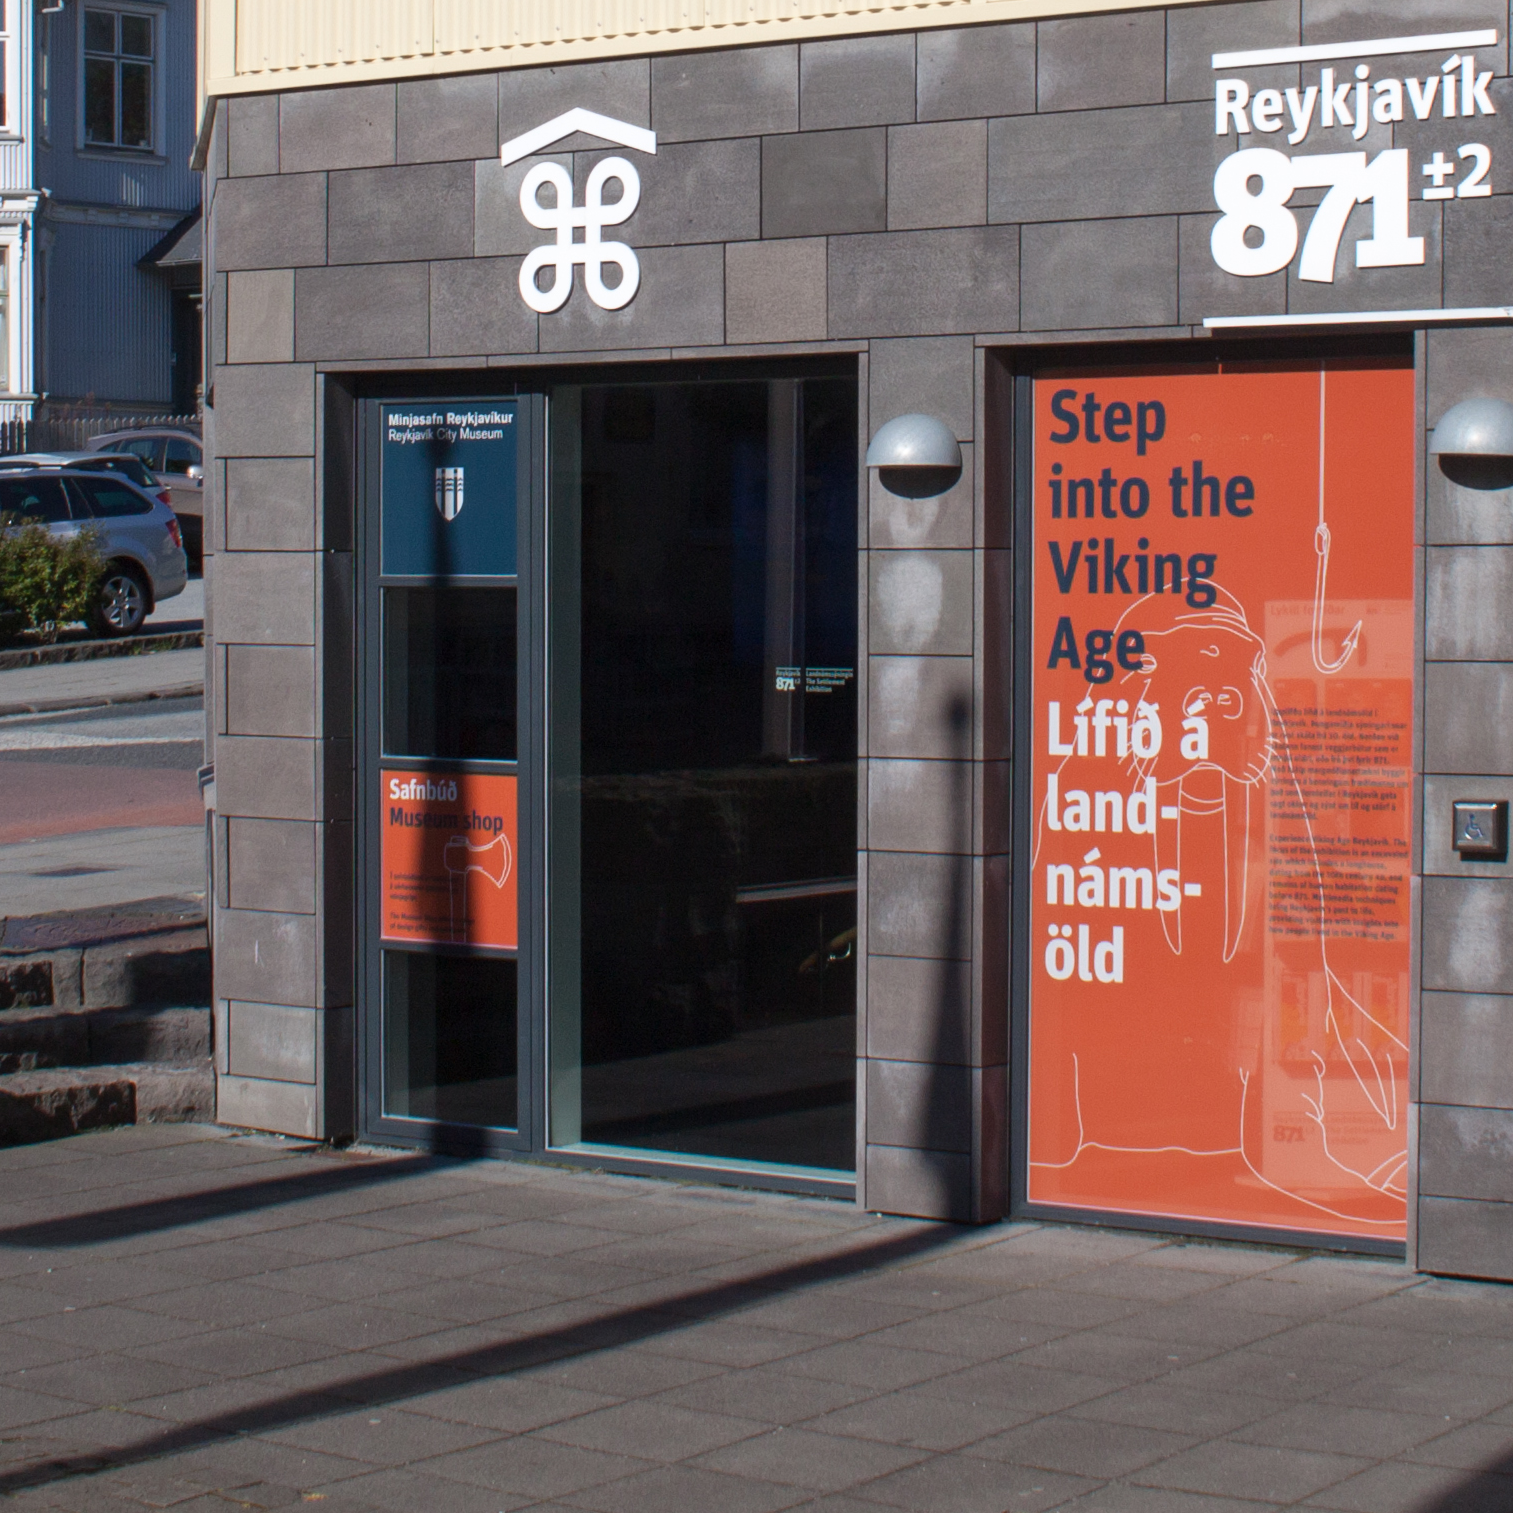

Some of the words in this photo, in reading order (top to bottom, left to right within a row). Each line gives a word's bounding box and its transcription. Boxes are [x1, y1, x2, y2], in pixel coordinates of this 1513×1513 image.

[1215, 53, 1496, 145] Reykjavík
[389, 413, 443, 427] Minjasafn
[437, 428, 457, 443] City
[459, 428, 503, 439] Museum
[1049, 388, 1166, 456] Step
[1048, 462, 1150, 519] into
[1168, 460, 1255, 518] the
[1047, 537, 1217, 610] Viking
[1046, 616, 1145, 685] Age
[1047, 696, 1163, 760] Lífið
[1179, 697, 1209, 761] á
[389, 778, 458, 802] Safnbúð
[1046, 773, 1178, 835] land-
[389, 807, 458, 829] Museum
[463, 810, 504, 836] shop
[1046, 846, 1202, 913] náms-
[1044, 924, 1124, 984] öld
